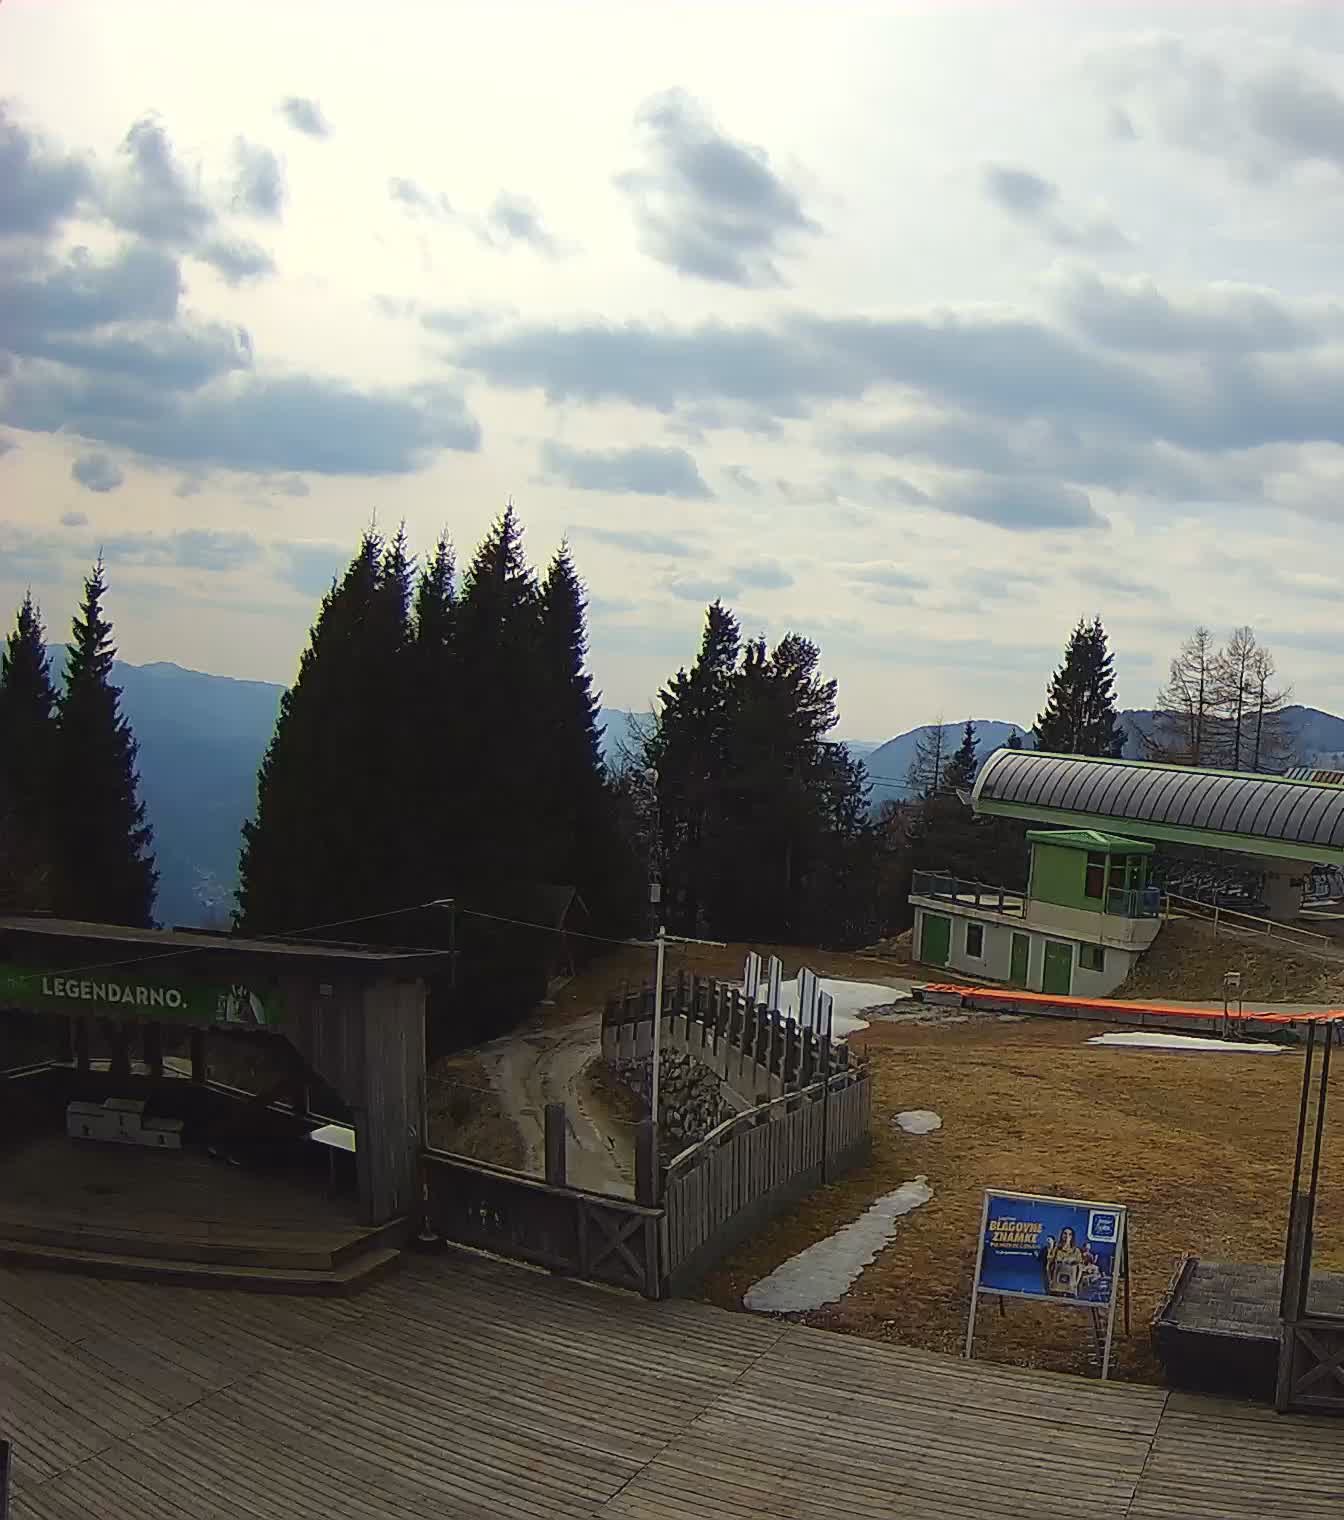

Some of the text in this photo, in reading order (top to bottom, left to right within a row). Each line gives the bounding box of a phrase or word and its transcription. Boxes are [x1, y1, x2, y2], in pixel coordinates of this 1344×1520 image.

[41, 976, 188, 1009] LEGENDARNO.
[989, 1220, 1042, 1233] BLAGOVNE
[992, 1232, 1038, 1243] ZNAMKE
